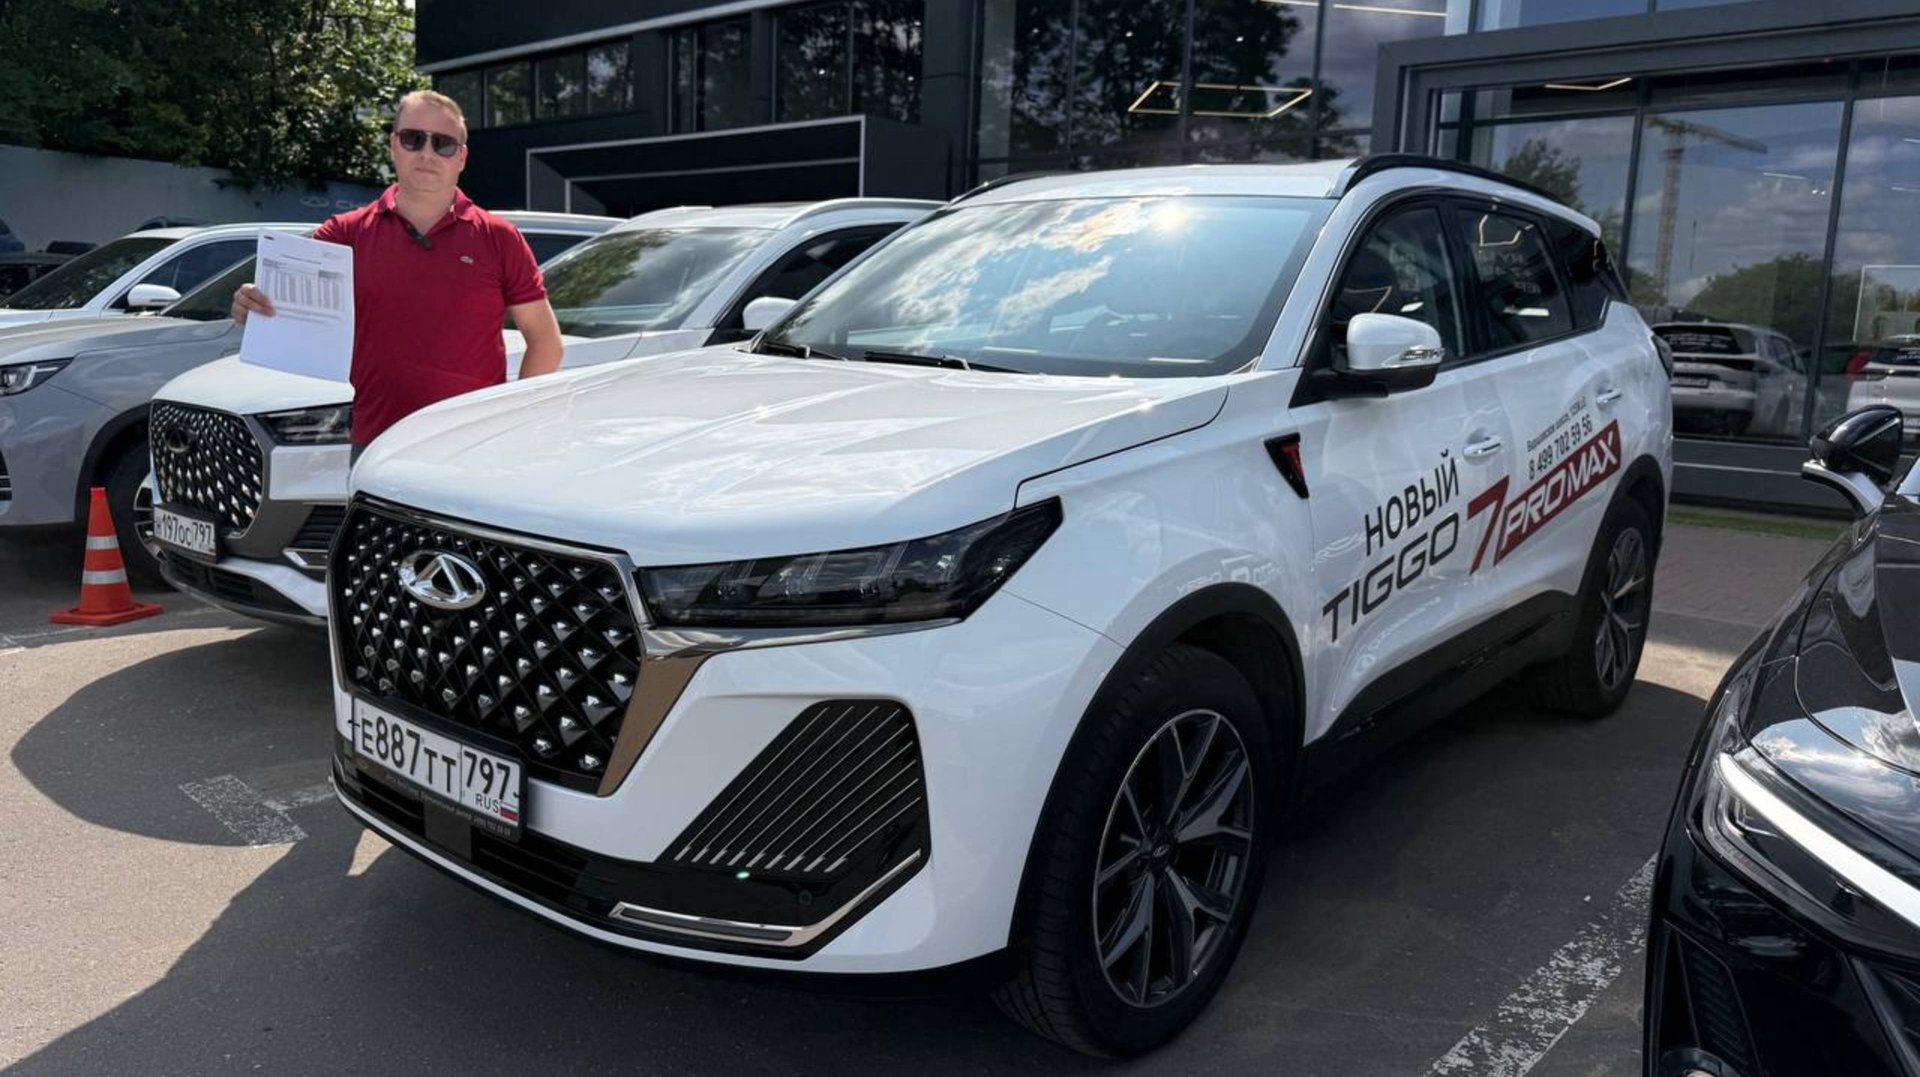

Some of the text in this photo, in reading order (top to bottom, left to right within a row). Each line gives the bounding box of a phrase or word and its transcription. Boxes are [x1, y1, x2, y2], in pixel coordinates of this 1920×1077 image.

[1529, 459, 1536, 481] 8
[1537, 444, 1553, 472] 499
[1554, 431, 1570, 460] 702
[1571, 421, 1581, 446] 59
[192, 521, 212, 545] 797
[1364, 448, 1459, 557] НОВЫЙ
[1322, 512, 1459, 643] TIGGO
[1467, 474, 1510, 576] 7
[361, 716, 511, 800] Е887ТТ 797
[475, 793, 500, 814] RUS
